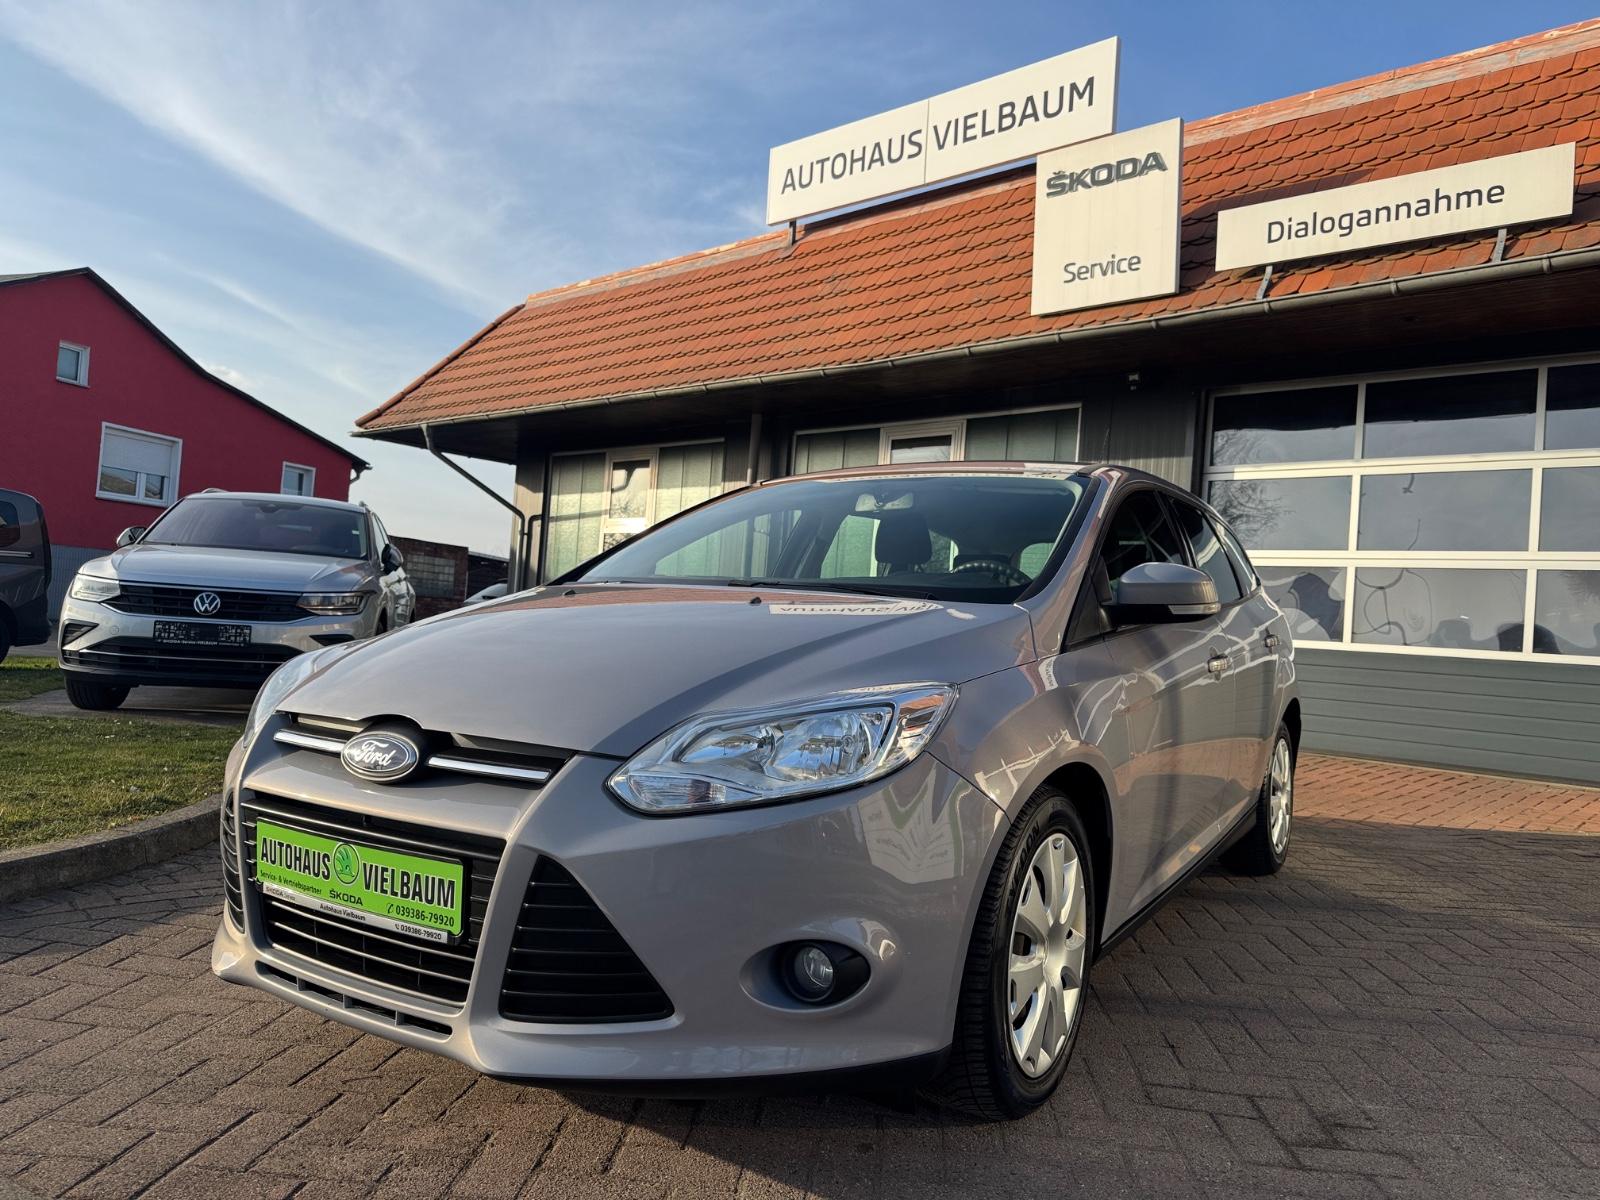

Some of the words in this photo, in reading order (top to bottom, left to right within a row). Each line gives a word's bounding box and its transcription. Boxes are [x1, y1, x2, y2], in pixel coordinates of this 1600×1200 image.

[781, 129, 923, 195] AUTOHAUS
[932, 76, 1095, 151] VIELBAUM
[1045, 151, 1168, 199] ŠKODA
[1266, 183, 1506, 245] Dialogannahme
[1063, 253, 1142, 285] Service
[351, 740, 397, 766] Ford
[261, 837, 331, 881] AUTOHAUS
[363, 863, 455, 909] VIELBAUM
[320, 903, 342, 915] Autohaus
[342, 909, 366, 921] Vielbaum
[329, 889, 363, 906] ŠKODA
[396, 905, 455, 927] 039386-79920
[400, 924, 442, 940] 039386-79920
